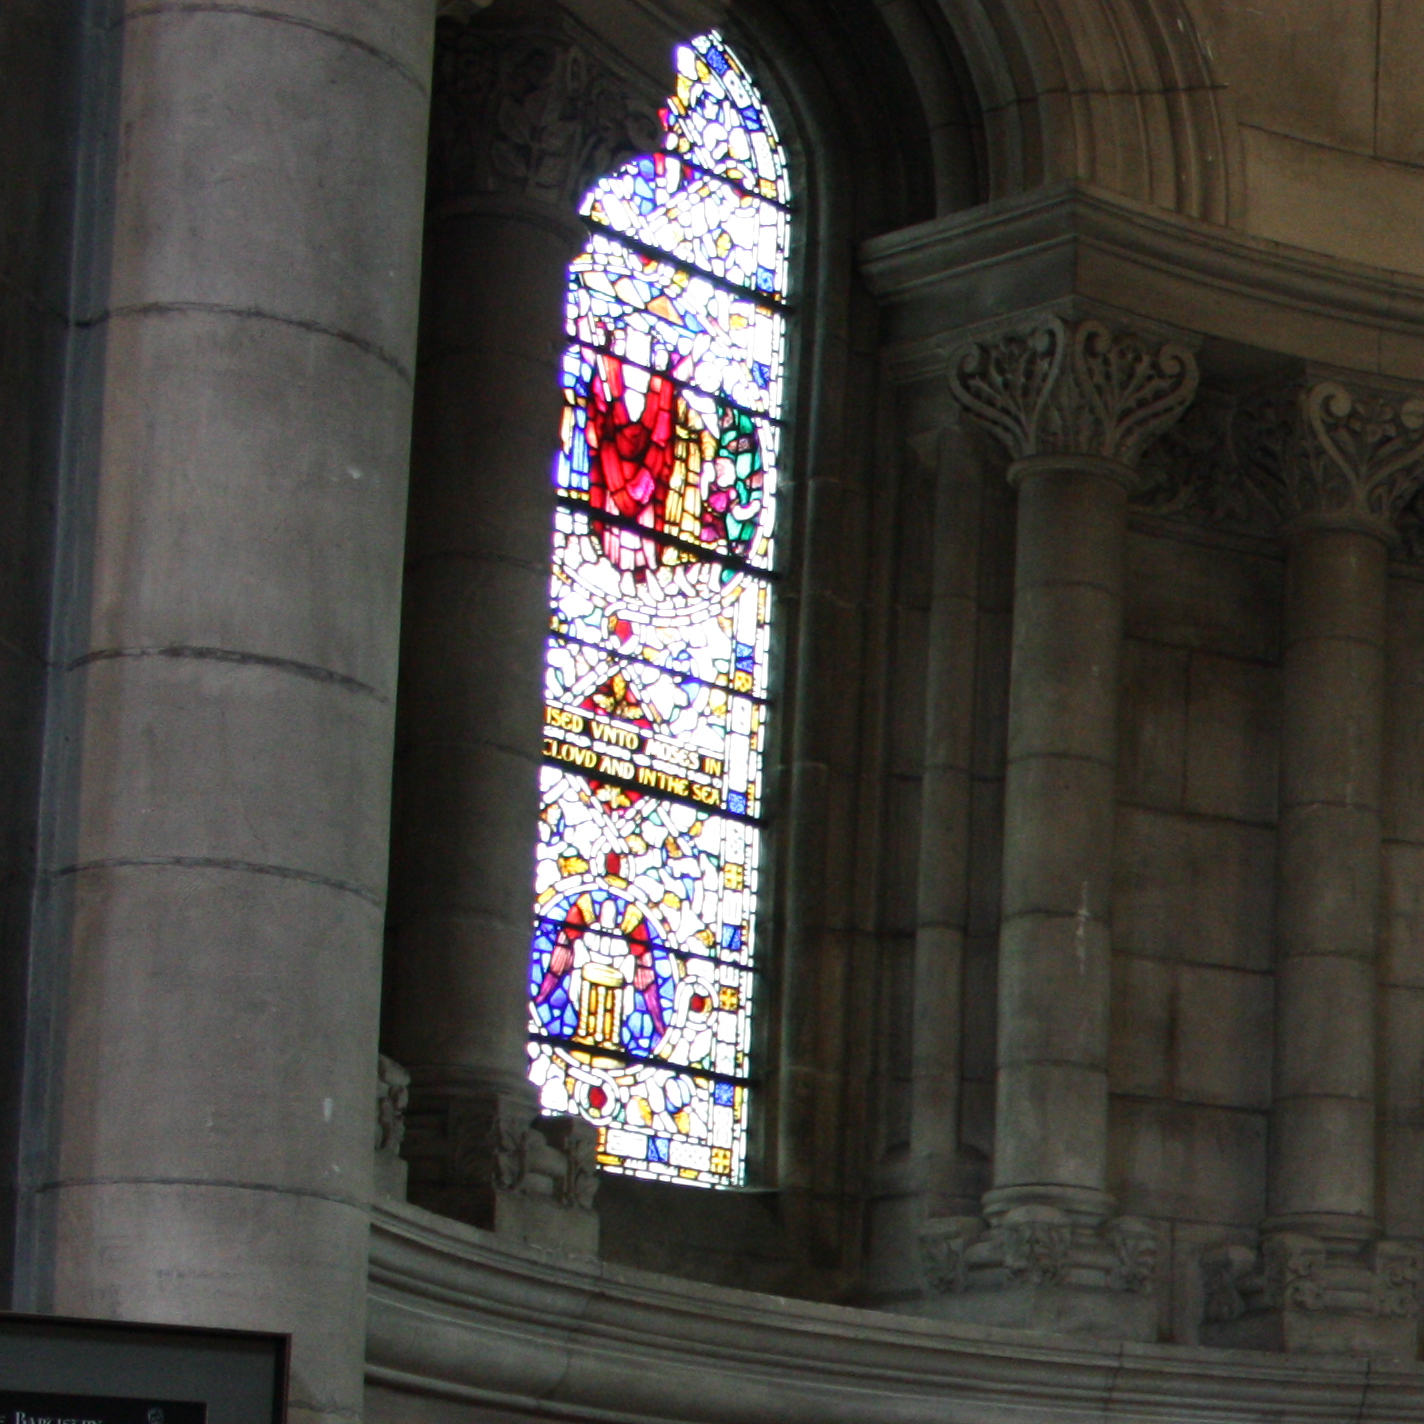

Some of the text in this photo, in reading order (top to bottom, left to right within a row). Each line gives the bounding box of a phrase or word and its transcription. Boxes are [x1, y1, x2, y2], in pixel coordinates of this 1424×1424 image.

[545, 706, 722, 777] ISED VNTO MOSES IN
[599, 754, 635, 780] AND
[638, 767, 657, 787] IN
[657, 771, 690, 797] THE
[691, 782, 721, 806] SEA
